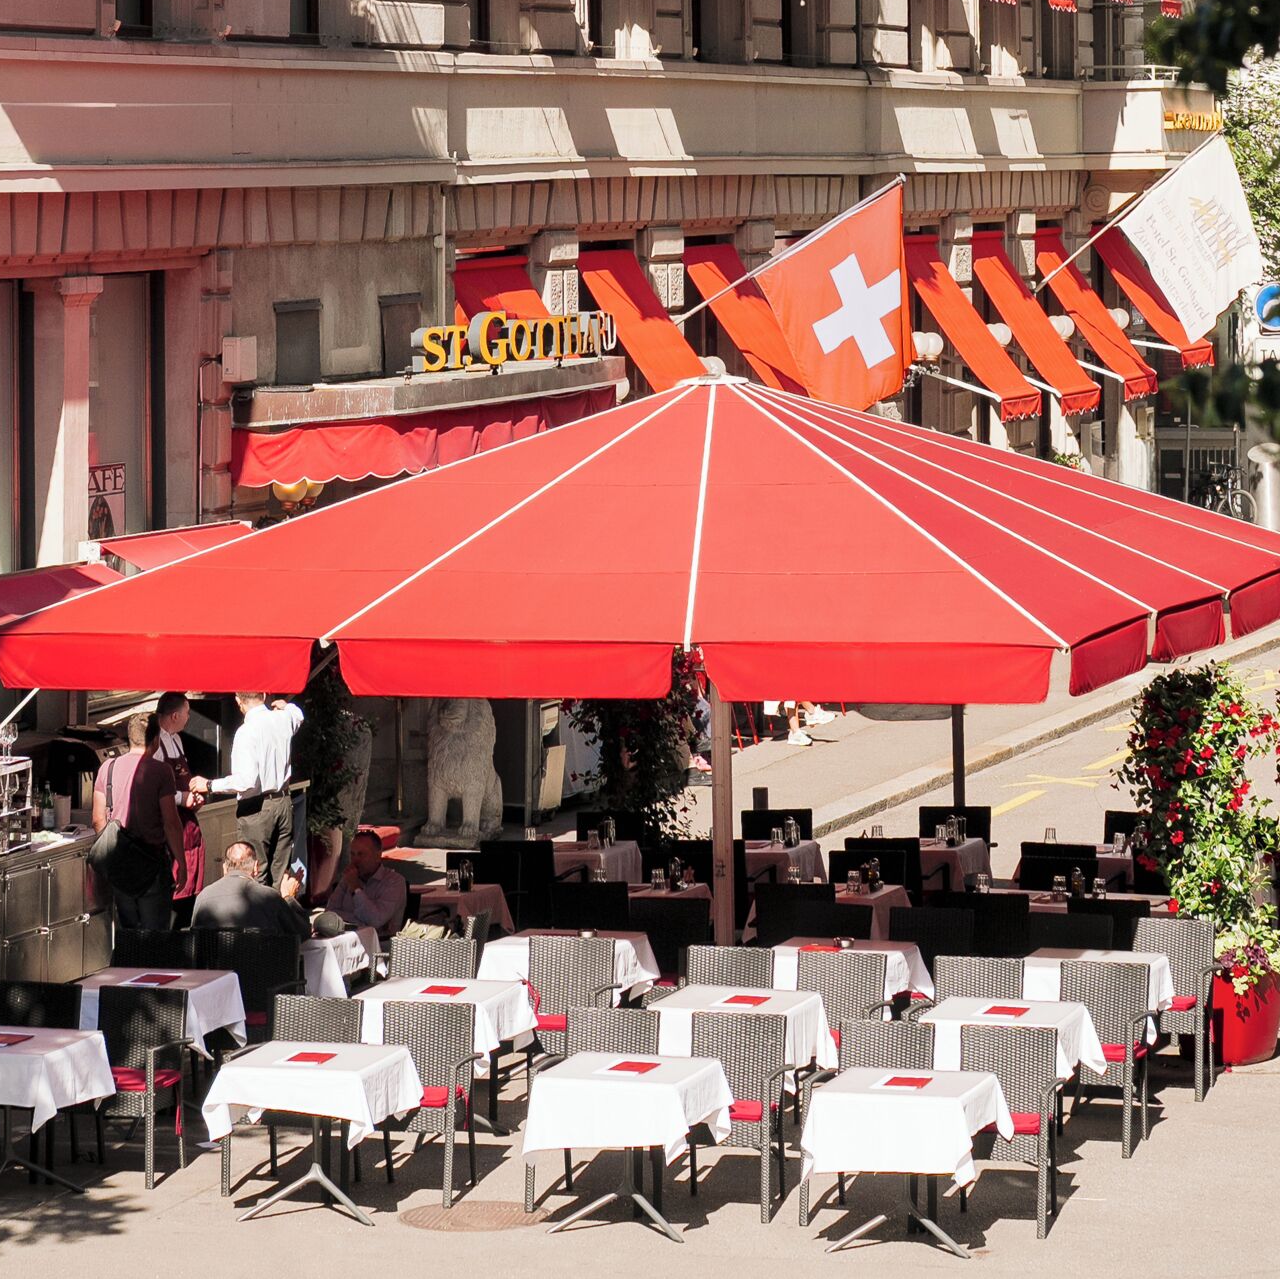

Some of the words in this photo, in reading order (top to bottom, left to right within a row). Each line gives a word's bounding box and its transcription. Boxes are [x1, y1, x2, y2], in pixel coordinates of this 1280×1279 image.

[1145, 215, 1172, 249] Hotel
[413, 324, 473, 372] ST.
[472, 310, 617, 365] GOTTHARD
